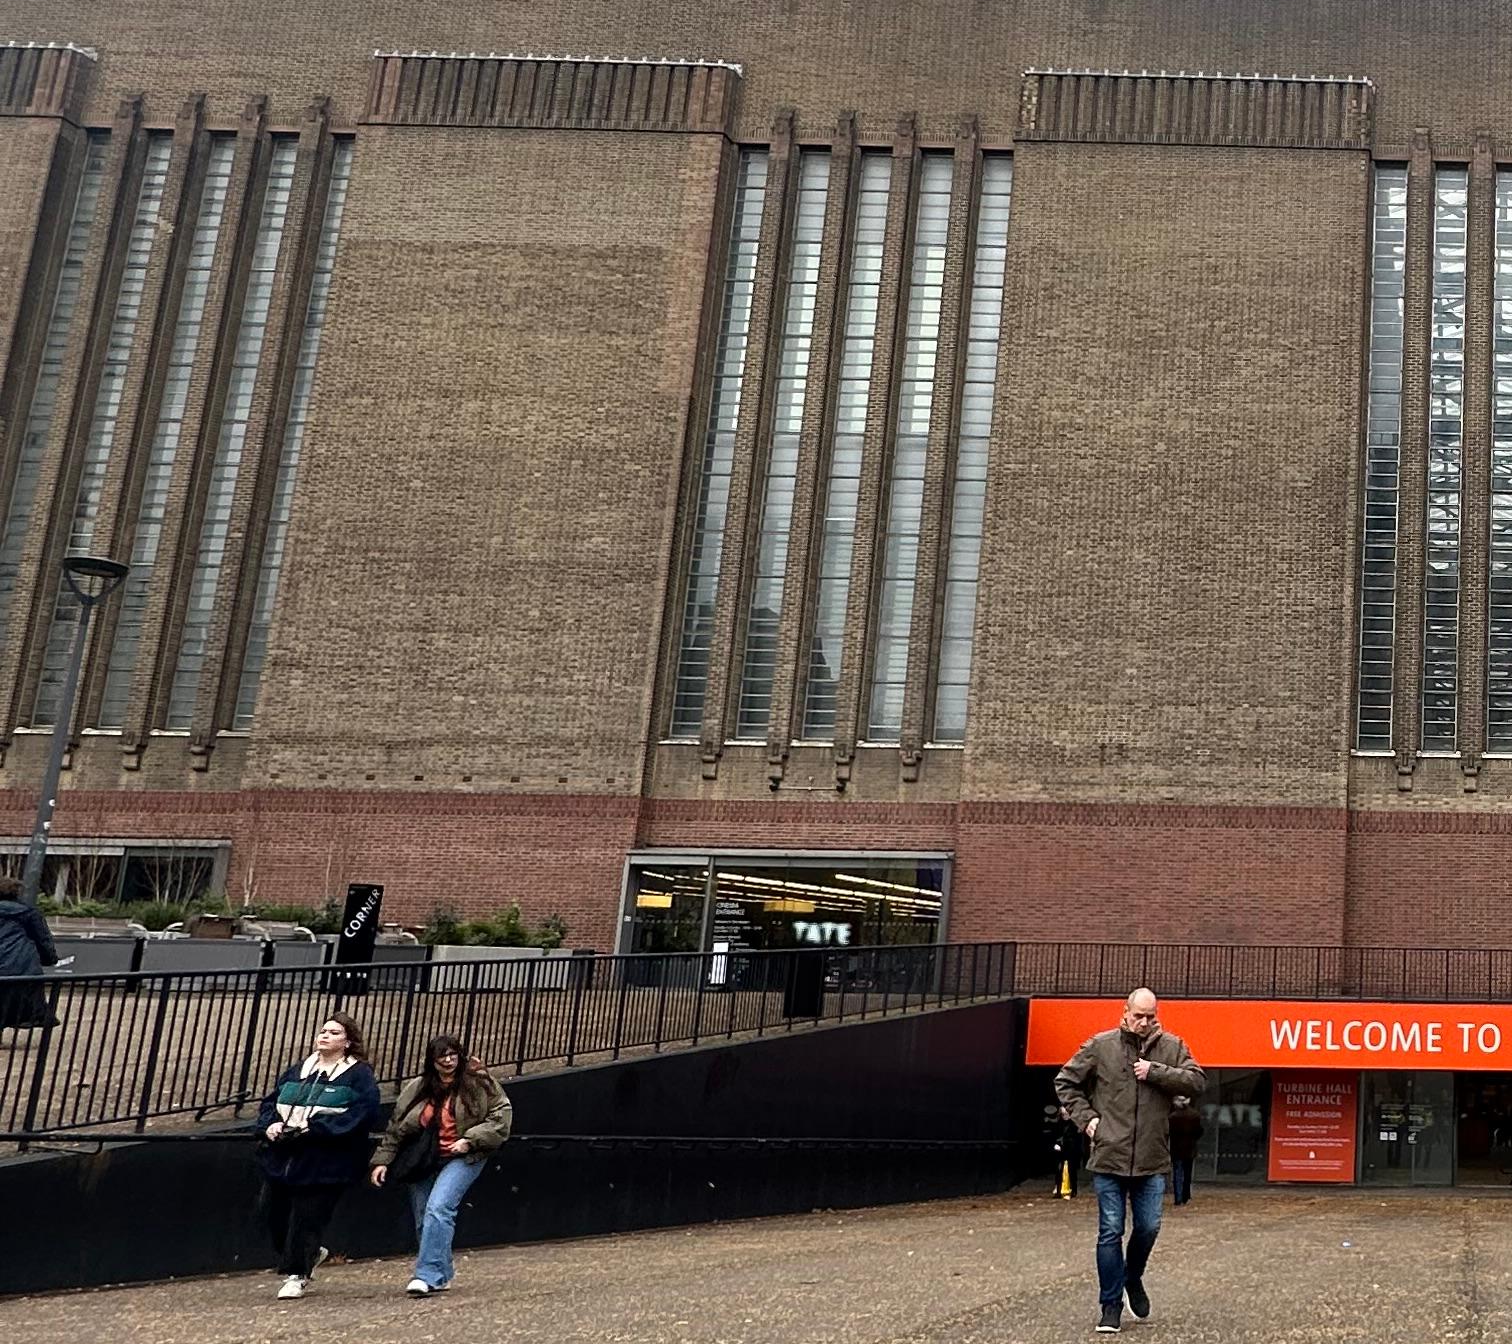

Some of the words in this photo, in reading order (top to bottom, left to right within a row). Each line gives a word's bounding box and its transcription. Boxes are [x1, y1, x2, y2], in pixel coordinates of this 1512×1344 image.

[344, 889, 380, 937] CORNER
[793, 921, 851, 946] TATE
[1270, 1019, 1443, 1053] WELCOME
[1457, 1023, 1501, 1053] TO
[1277, 1082, 1323, 1093] TURBINE
[1326, 1083, 1352, 1094] HALL
[1286, 1094, 1342, 1105] ENTRANCE
